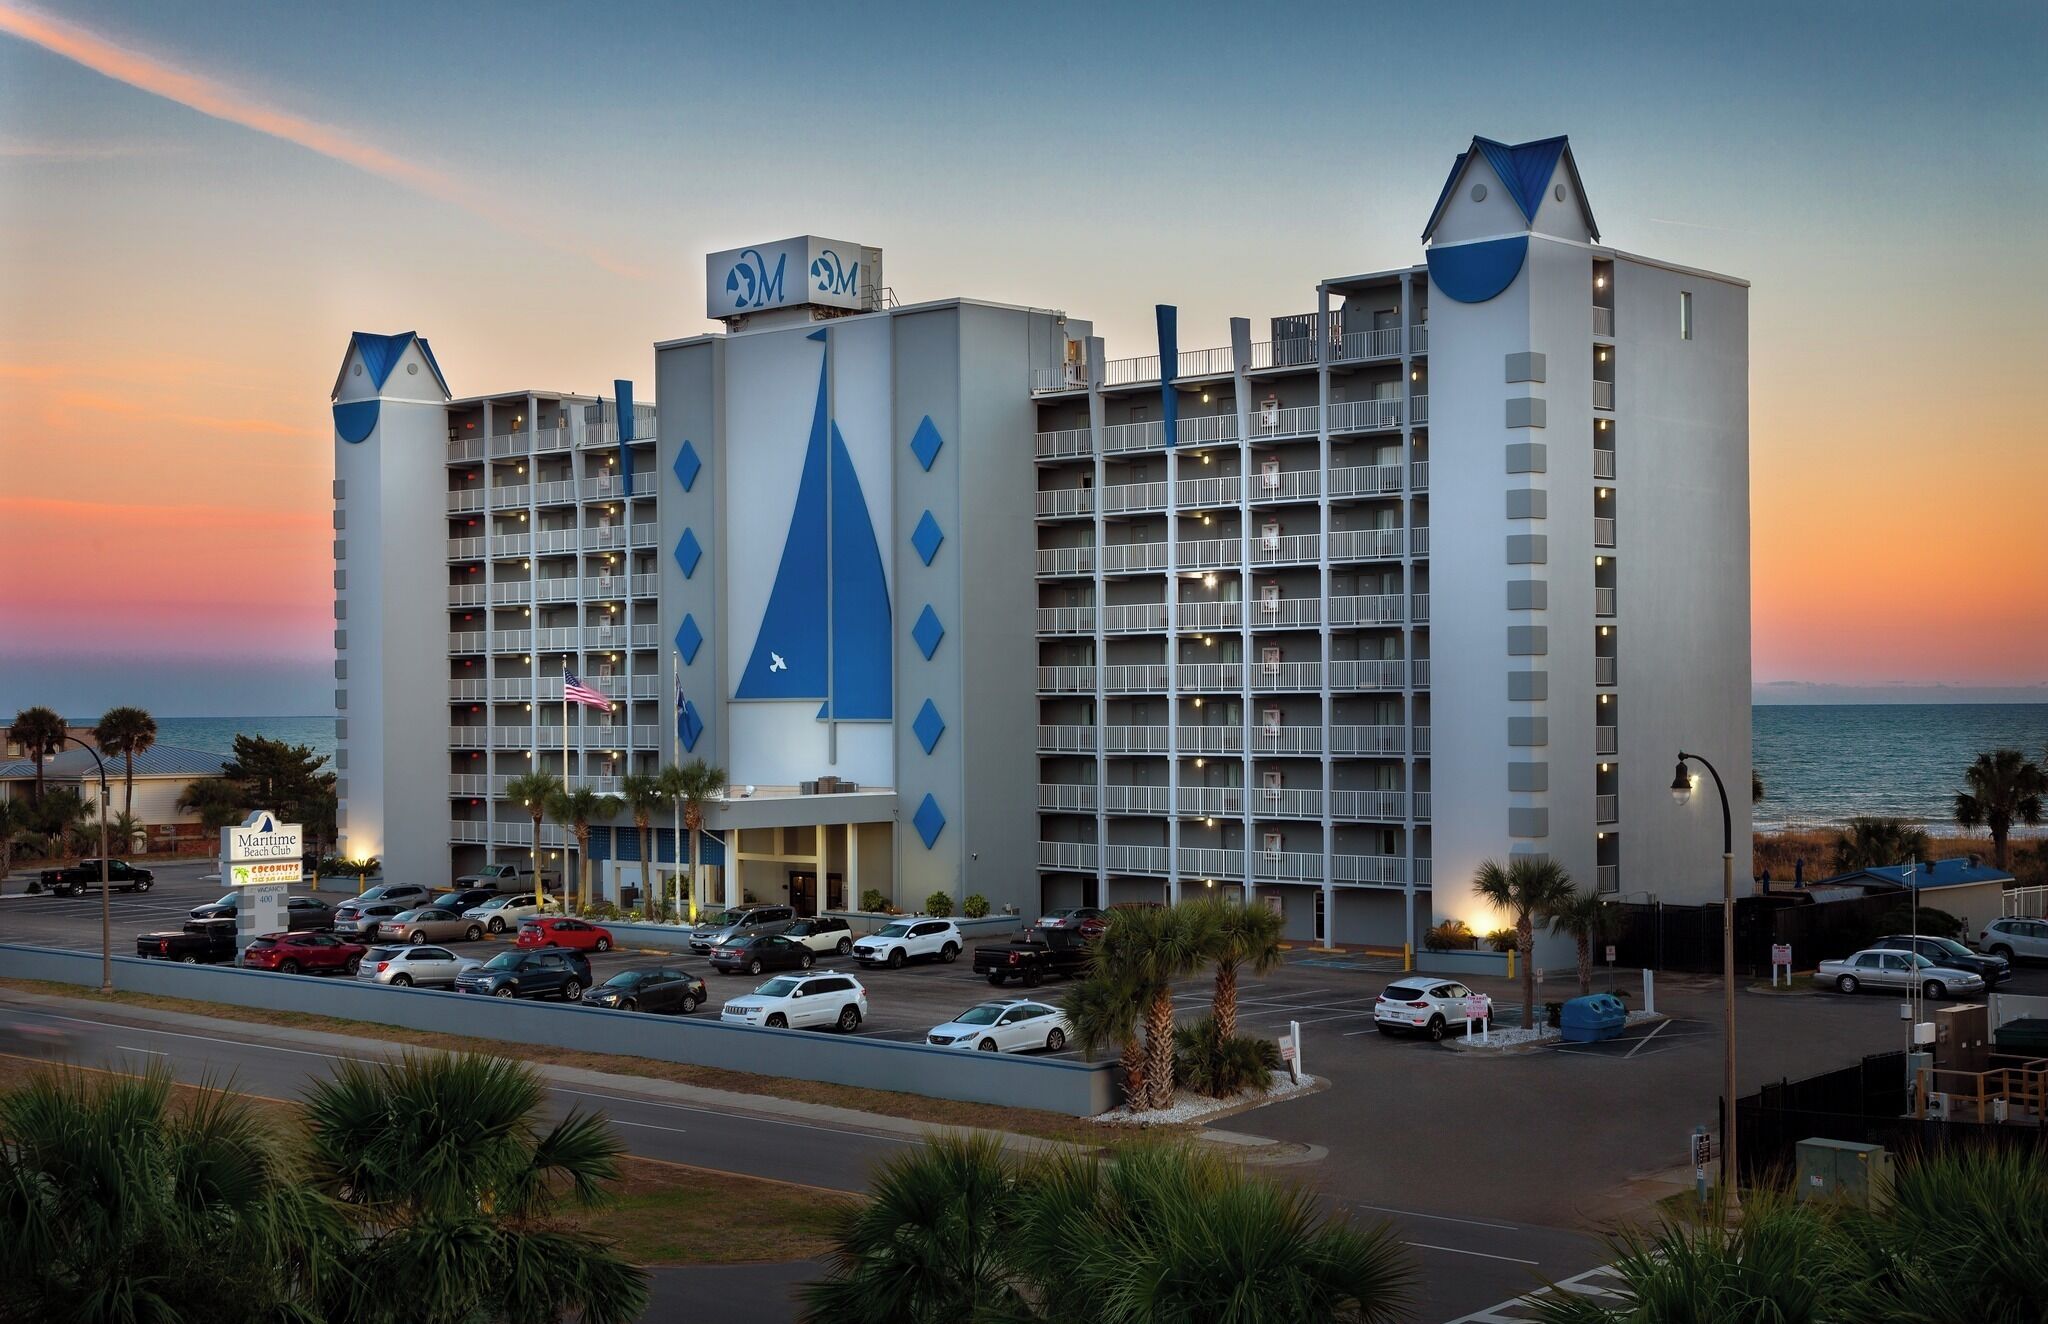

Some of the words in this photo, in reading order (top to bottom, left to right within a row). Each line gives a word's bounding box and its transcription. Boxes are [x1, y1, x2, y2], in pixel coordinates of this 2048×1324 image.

[238, 832, 297, 848] Maritime
[244, 846, 269, 857] Beach
[271, 845, 291, 856] Club
[251, 863, 299, 874] COCONUTS
[259, 895, 273, 904] 400
